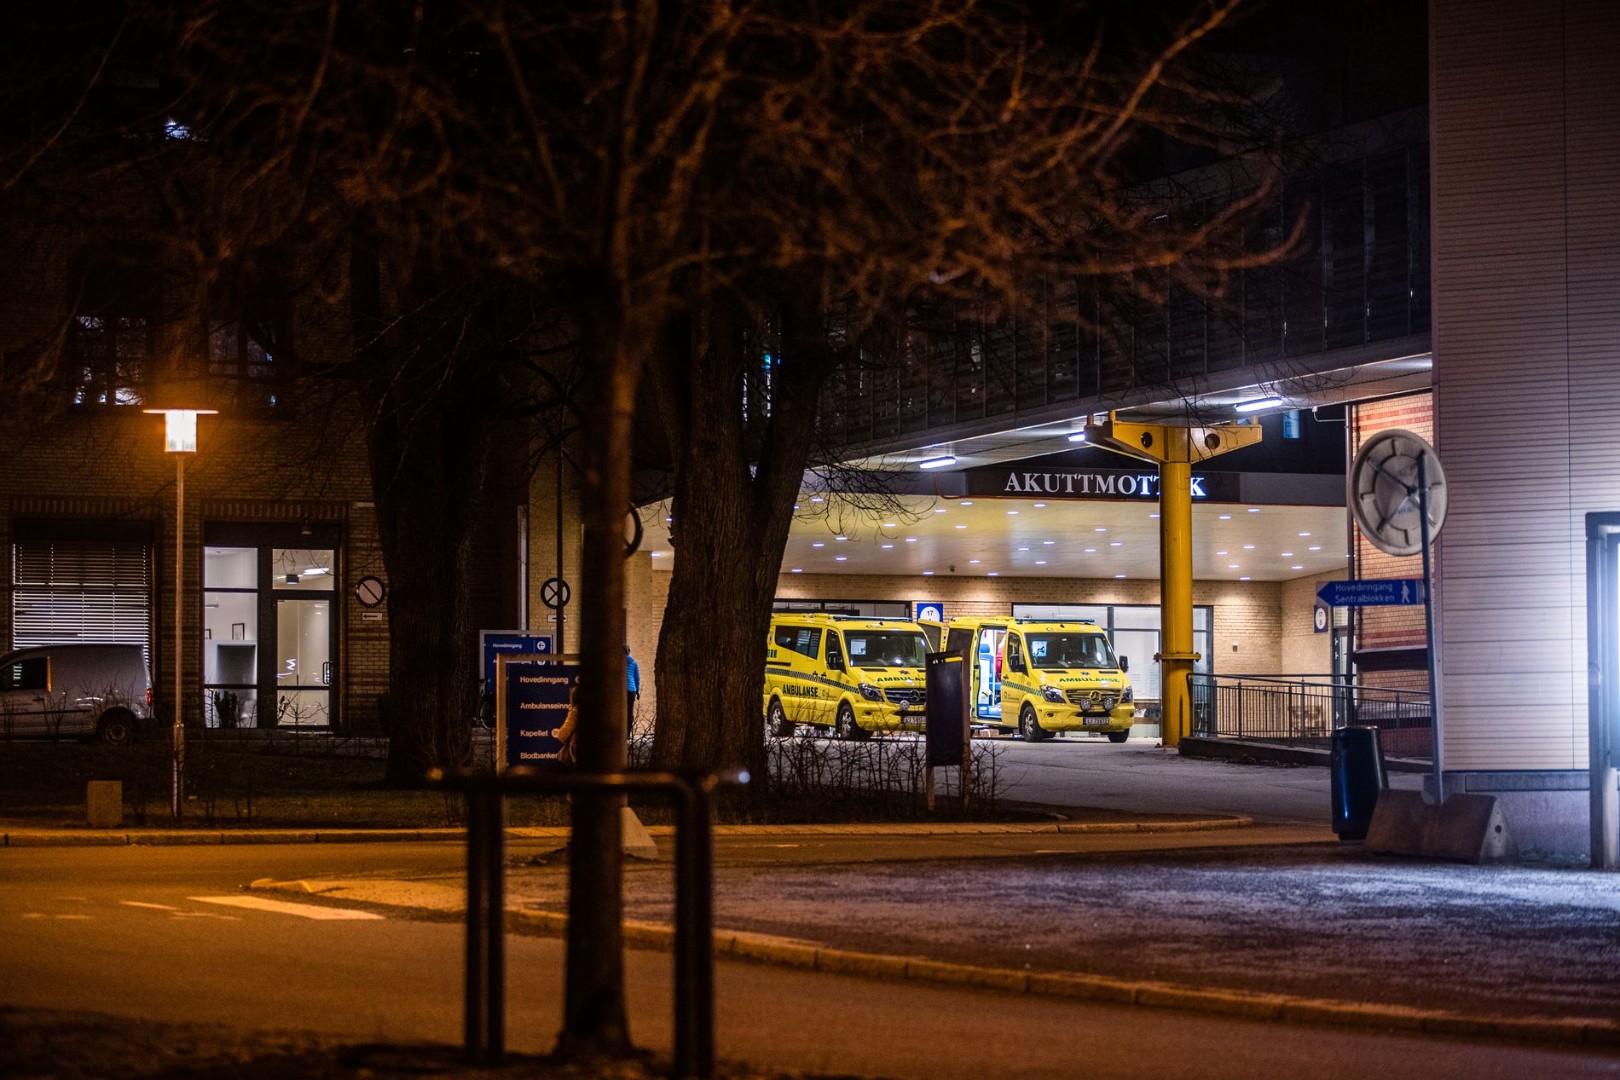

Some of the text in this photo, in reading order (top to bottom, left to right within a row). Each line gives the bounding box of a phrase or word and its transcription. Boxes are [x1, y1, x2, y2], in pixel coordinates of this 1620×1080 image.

[1004, 472, 1206, 496] AKUTTMOTK
[1335, 583, 1393, 592] Hovedinngang
[1335, 594, 1395, 603] Sentralblokken
[520, 676, 569, 685] Hovedinngang
[782, 684, 818, 698] AMBULANSE
[520, 702, 573, 710] Ambulanseinng
[520, 730, 549, 738] Kapellet
